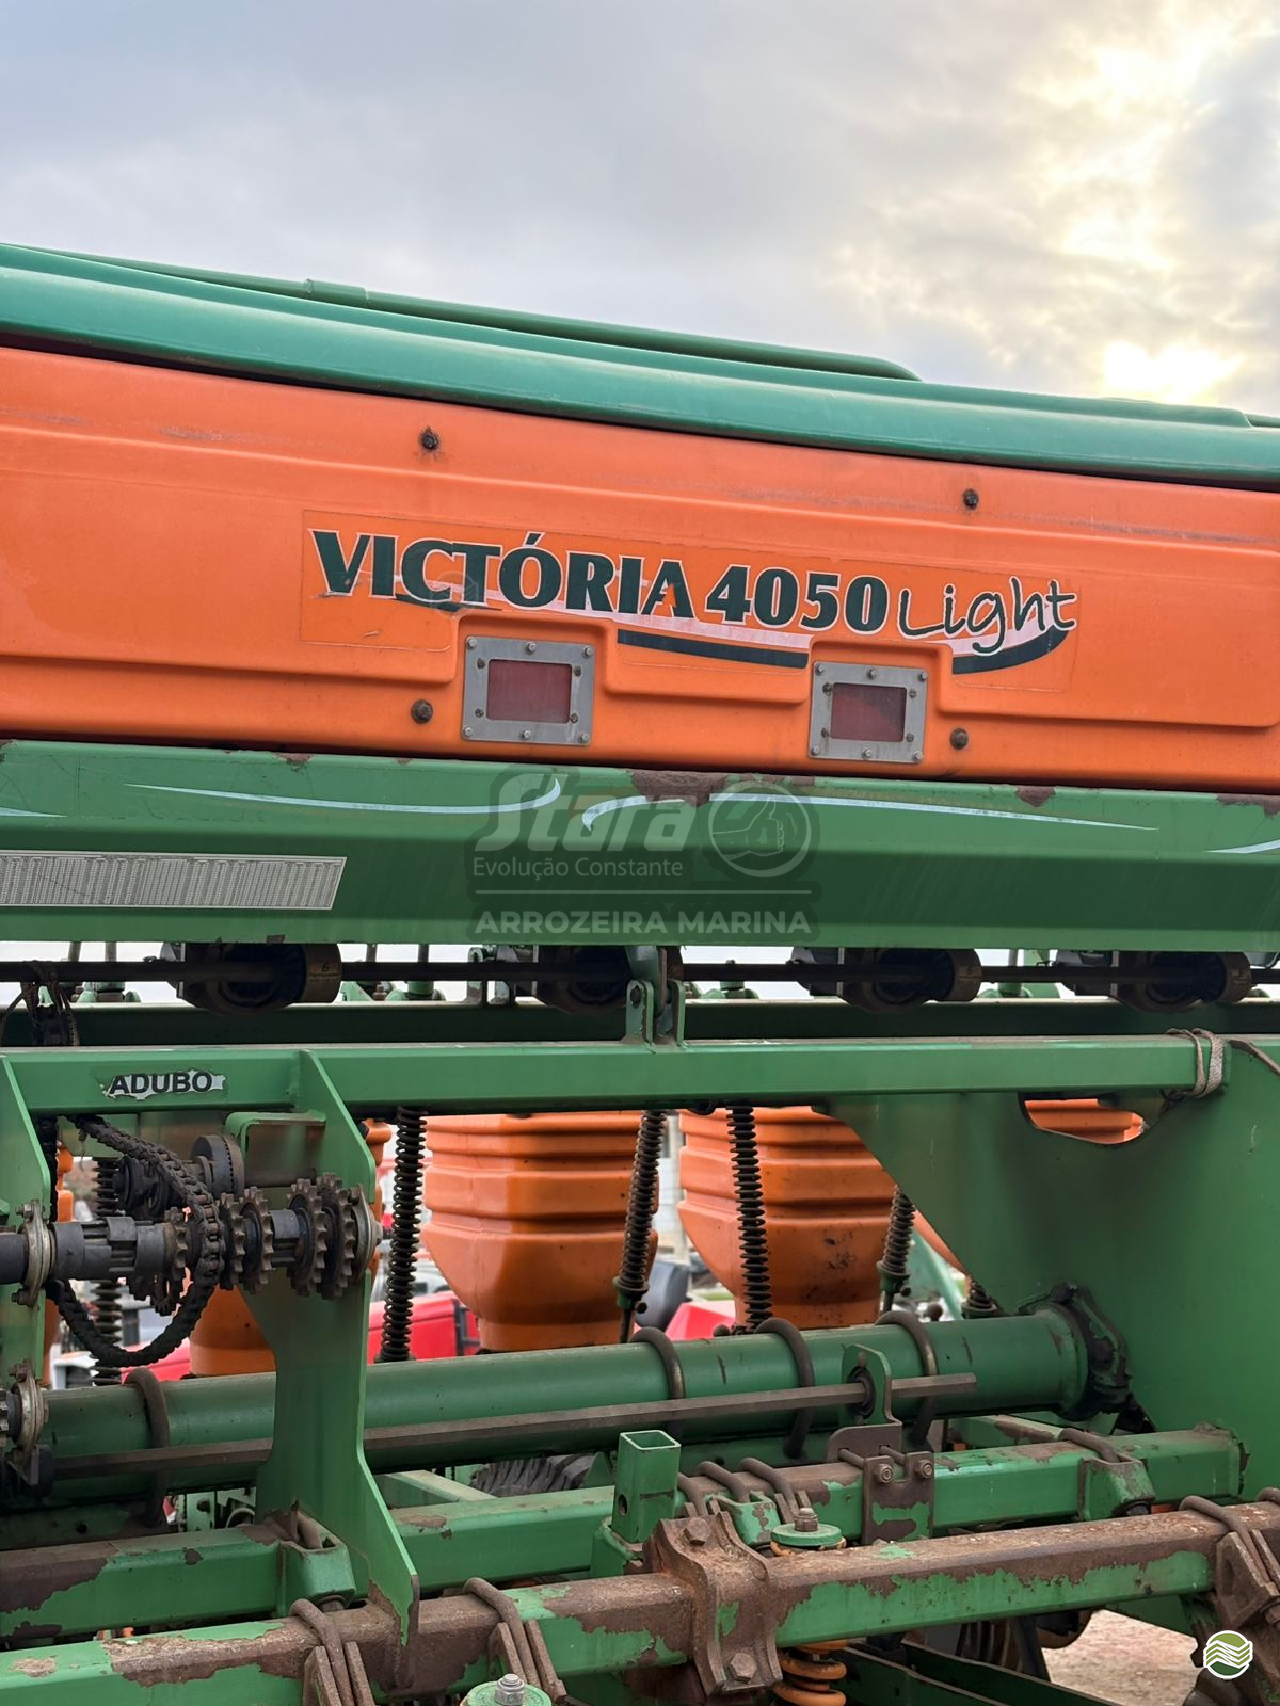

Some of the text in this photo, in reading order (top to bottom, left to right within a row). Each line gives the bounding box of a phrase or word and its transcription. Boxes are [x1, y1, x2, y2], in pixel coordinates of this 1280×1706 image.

[308, 530, 1077, 656] VICTÓRIA 4050 Light
[109, 1072, 213, 1094] ADUBO
